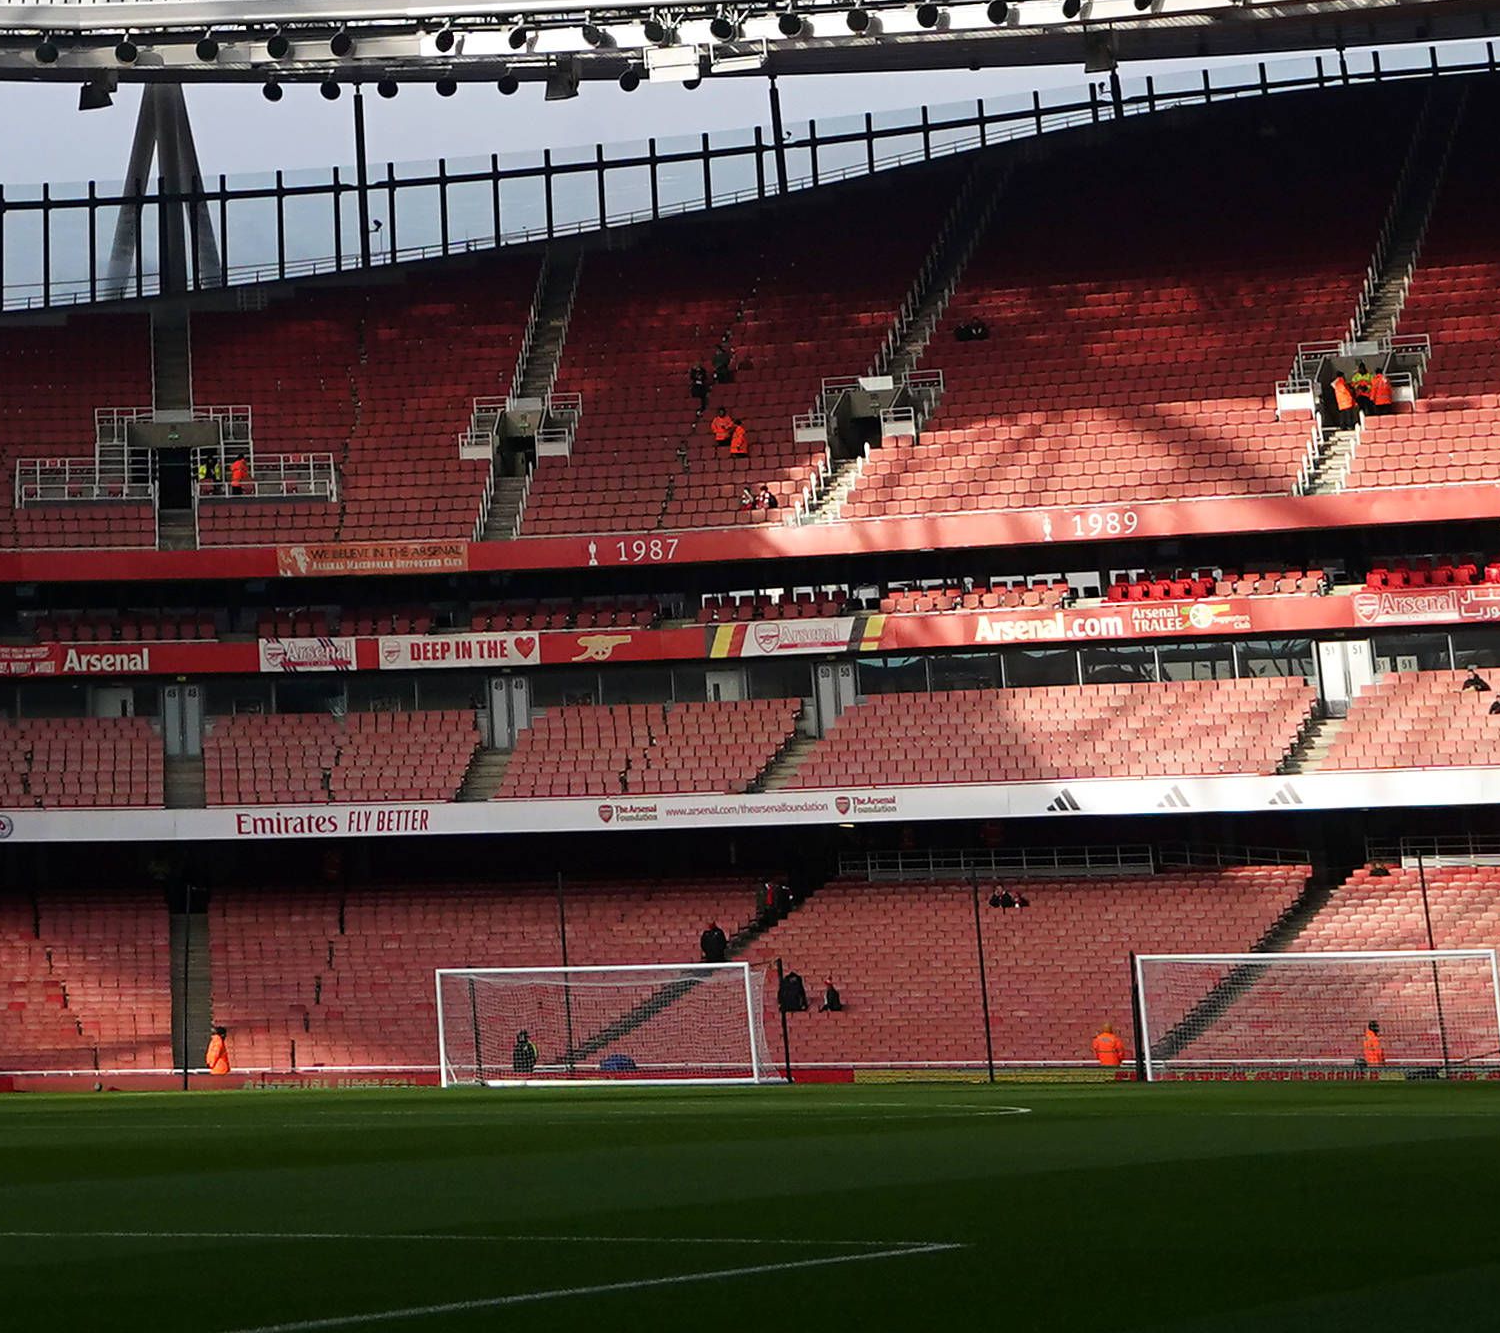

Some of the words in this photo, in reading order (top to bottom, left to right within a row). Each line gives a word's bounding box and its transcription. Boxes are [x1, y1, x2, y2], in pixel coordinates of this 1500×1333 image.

[1072, 512, 1138, 536] 1989
[311, 549, 329, 560] WE
[332, 549, 371, 559] BELIEVE
[374, 548, 384, 559] IN
[387, 548, 409, 558] THE
[412, 546, 461, 557] ARSENAL
[616, 538, 679, 562] 1987
[1379, 591, 1459, 615] Arsenal
[1131, 604, 1179, 619] Arsenal
[975, 612, 1123, 642] Arsenal.com
[1132, 618, 1184, 633] TRALEE
[1233, 621, 1251, 629] Club
[780, 624, 840, 643] Arsenal
[286, 640, 352, 661] Arsenal
[410, 641, 450, 660] DEEP
[454, 641, 472, 659] IN
[474, 639, 508, 659] THE
[1353, 643, 1362, 655] 51
[63, 646, 150, 672] Arsenal
[1402, 660, 1412, 670] 51
[821, 667, 831, 679] 50
[840, 666, 850, 678] 50
[852, 796, 866, 805] The
[867, 795, 897, 805] Arsenal
[616, 805, 627, 814] The
[628, 804, 657, 813] Arsenal
[665, 801, 829, 817] www.arsenal.com/thearsenalfoundation
[853, 804, 897, 814] Foundation
[236, 812, 338, 835] Emirates
[348, 810, 372, 832] FLY
[377, 809, 430, 832] BETTER
[616, 813, 658, 823] Foundation
